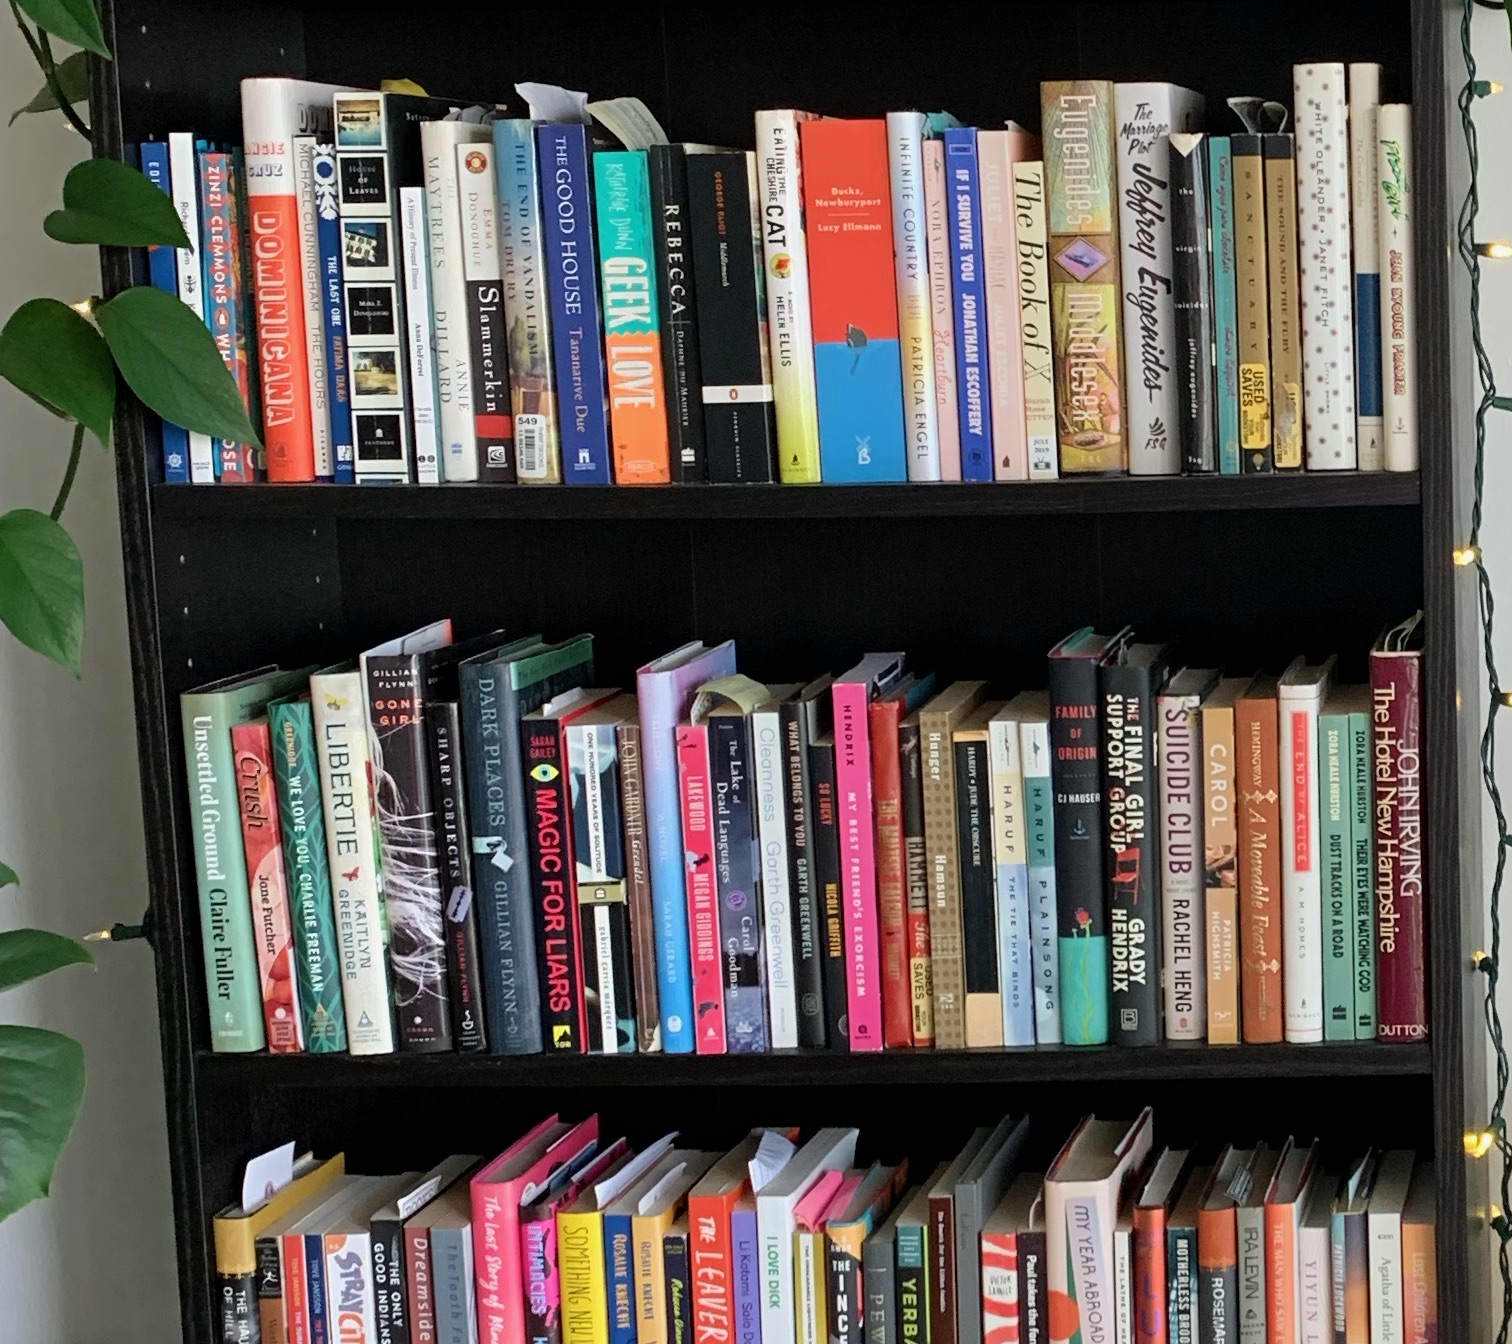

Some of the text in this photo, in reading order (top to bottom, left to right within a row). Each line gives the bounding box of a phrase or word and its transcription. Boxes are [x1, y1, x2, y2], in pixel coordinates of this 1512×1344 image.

[818, 224, 841, 232] Lucy
[955, 169, 970, 182] IF
[957, 194, 973, 250] SURVIVE
[555, 136, 588, 433] THE GOOD HOUSE Tananarive Due
[665, 205, 685, 315] REBECCA
[960, 254, 974, 282] YOU
[1015, 173, 1050, 383] The Book of X
[1054, 94, 1103, 422] Eugenides Middlesex
[1126, 163, 1171, 404] Jeffrey Eugenides
[253, 212, 294, 427] DOMINICANA
[477, 287, 500, 413] Slammerkin
[604, 257, 655, 409] GEEK LOVE
[962, 293, 979, 363] JONATHAN
[966, 367, 982, 436] ESCOFFERY
[326, 724, 359, 856] LIBERTIE
[1108, 694, 1126, 854] SUPPORT GROUP
[1125, 697, 1145, 843] THE FINAL GIRL
[1374, 683, 1400, 953] The Hotel New Hampshire
[1396, 740, 1422, 896] JOHN IRVING
[193, 715, 236, 1000] Unsettled Ground Claire Fuller
[536, 789, 571, 1013] MAGIC FOR LIARS
[1165, 709, 1193, 1013] SUICIDE CLUB RACHEL HENG
[1112, 909, 1128, 992] HENDRIX
[1129, 918, 1145, 985] GRADY
[1379, 1025, 1427, 1037] DUTTON
[224, 1286, 235, 1304] OF
[236, 1290, 248, 1314] THE
[374, 1243, 388, 1285] GOOD
[389, 1261, 403, 1327] THE ONLY
[1176, 1239, 1190, 1310] MOTHERLESS
[225, 1310, 236, 1340] HILL
